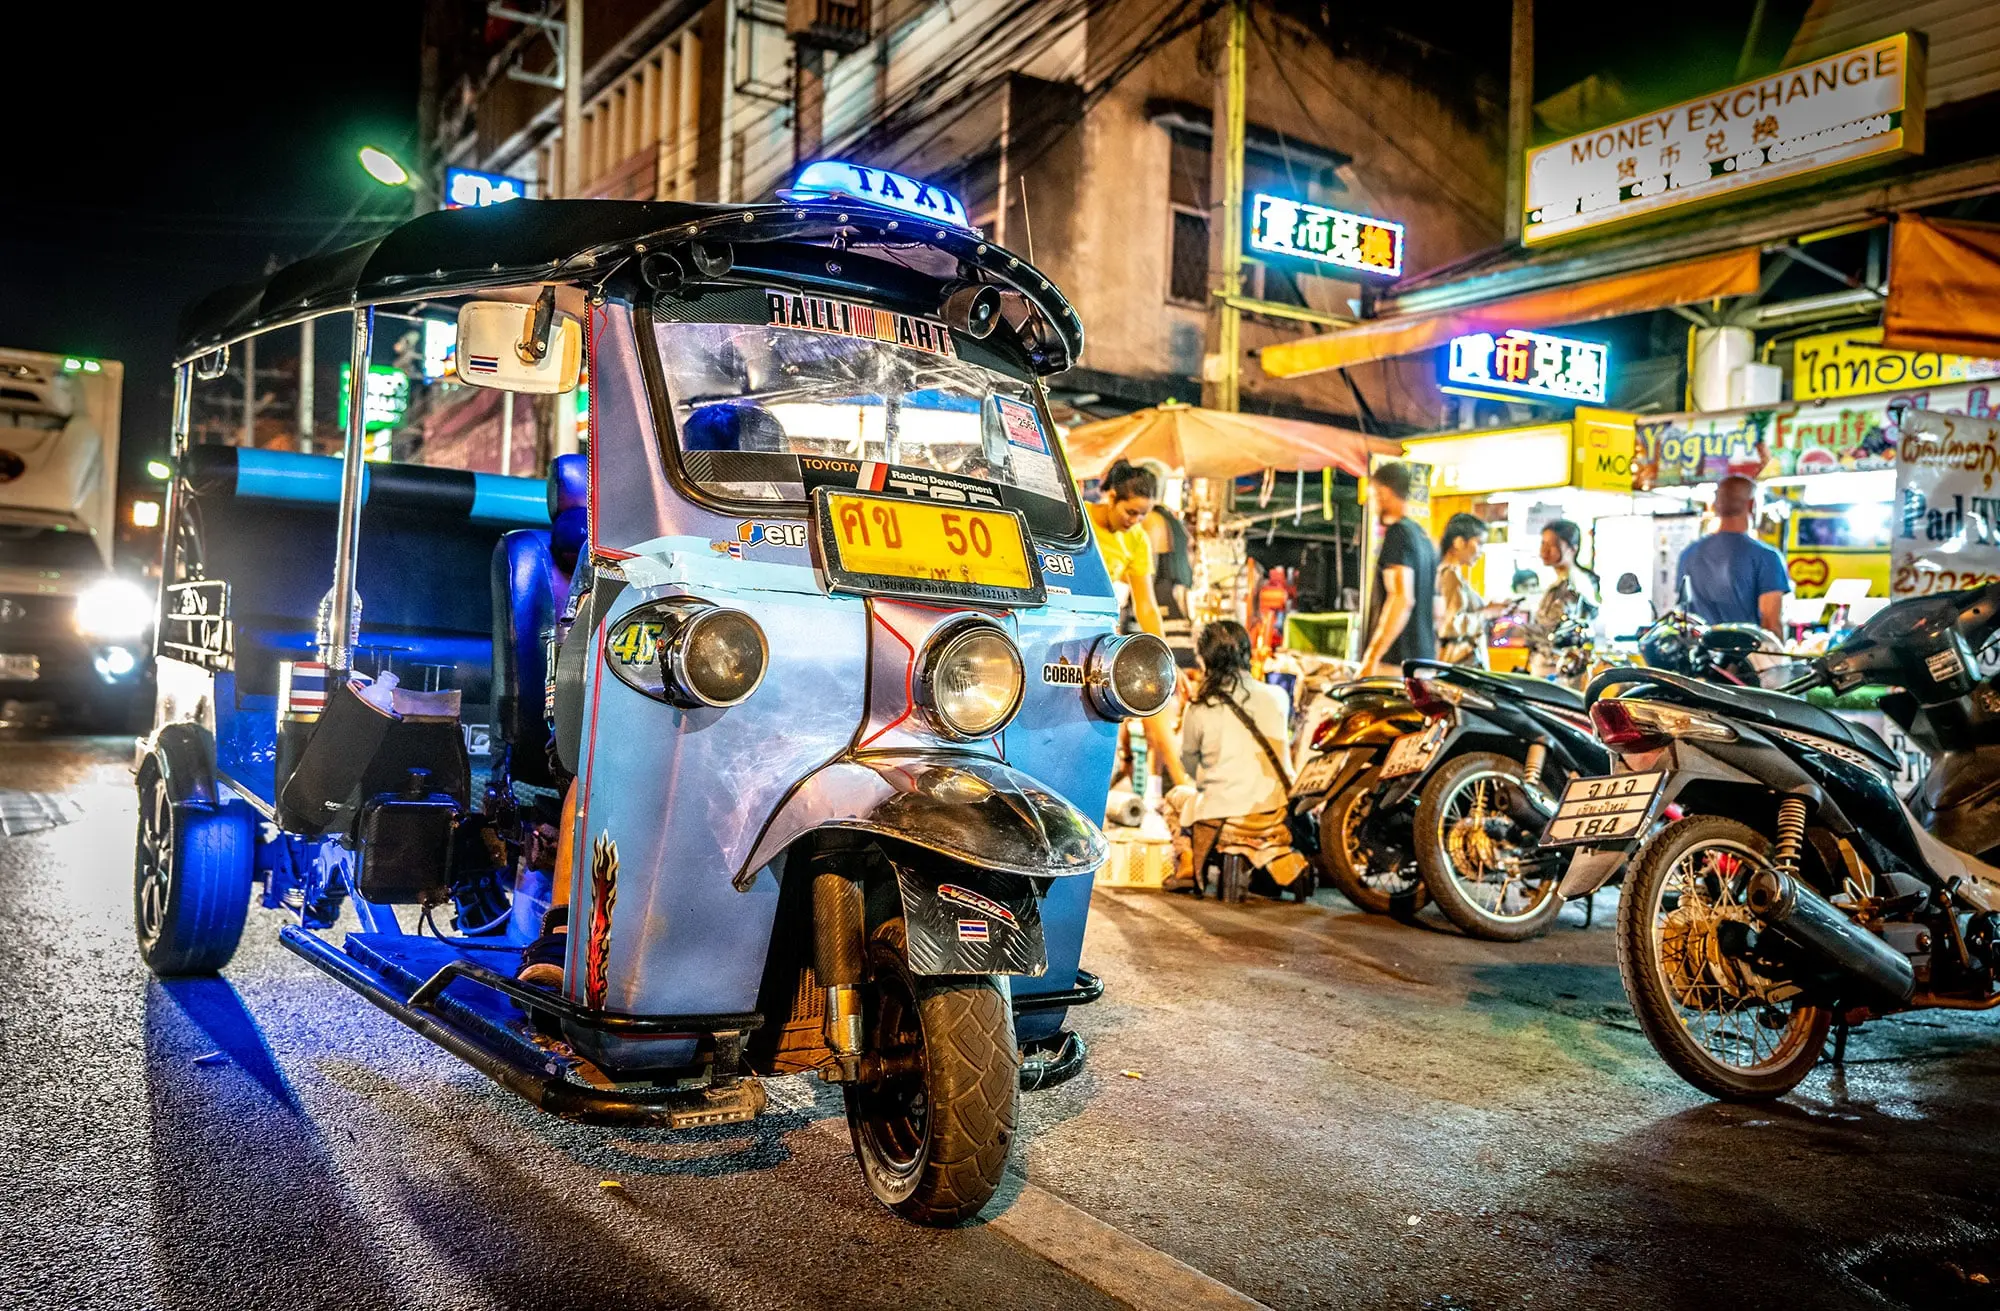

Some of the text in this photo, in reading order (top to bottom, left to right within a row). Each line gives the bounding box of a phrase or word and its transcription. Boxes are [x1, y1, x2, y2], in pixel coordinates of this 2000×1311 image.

[1571, 112, 1676, 167] MONEY
[1687, 44, 1899, 133] EXCHANGE
[848, 165, 956, 215] TAXI
[766, 292, 951, 356] RALLI ART
[1800, 344, 1943, 394] ไก่ทอด
[1642, 420, 1758, 470] Yogurt
[1775, 406, 1867, 449] Fruit
[802, 458, 859, 473] TOYOTA
[891, 470, 929, 484] Racing
[928, 475, 994, 496] Development
[764, 525, 806, 546] elf
[839, 500, 993, 559] ศข 50
[1901, 488, 1965, 543] Pad
[1044, 554, 1074, 576] elf
[1043, 664, 1084, 685] COBRA
[1572, 816, 1620, 837] 184
